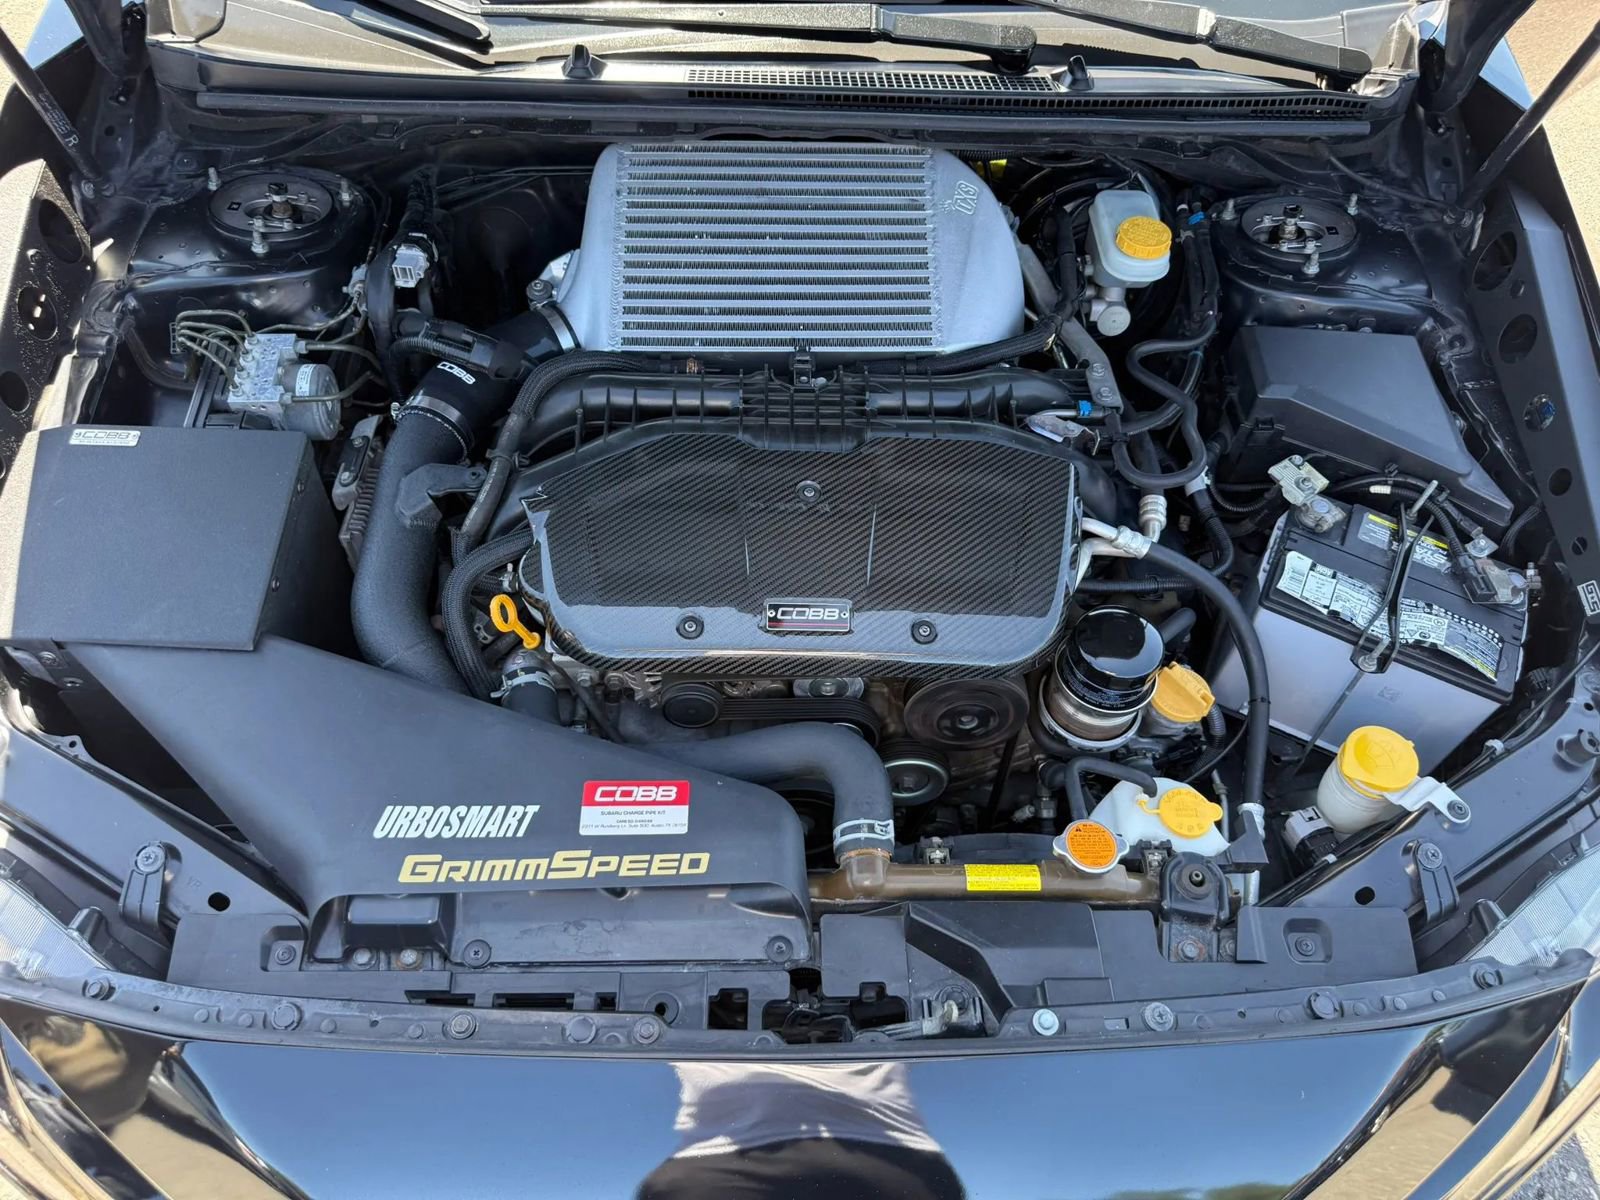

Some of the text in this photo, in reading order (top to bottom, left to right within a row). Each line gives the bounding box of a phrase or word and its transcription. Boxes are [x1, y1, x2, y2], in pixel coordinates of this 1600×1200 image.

[437, 361, 476, 385] COBB
[82, 431, 131, 440] COBB
[776, 607, 839, 620] COBB
[594, 785, 678, 802] COBB
[373, 804, 540, 839] URBOSMART
[398, 849, 711, 883] GRIMMSPEED
